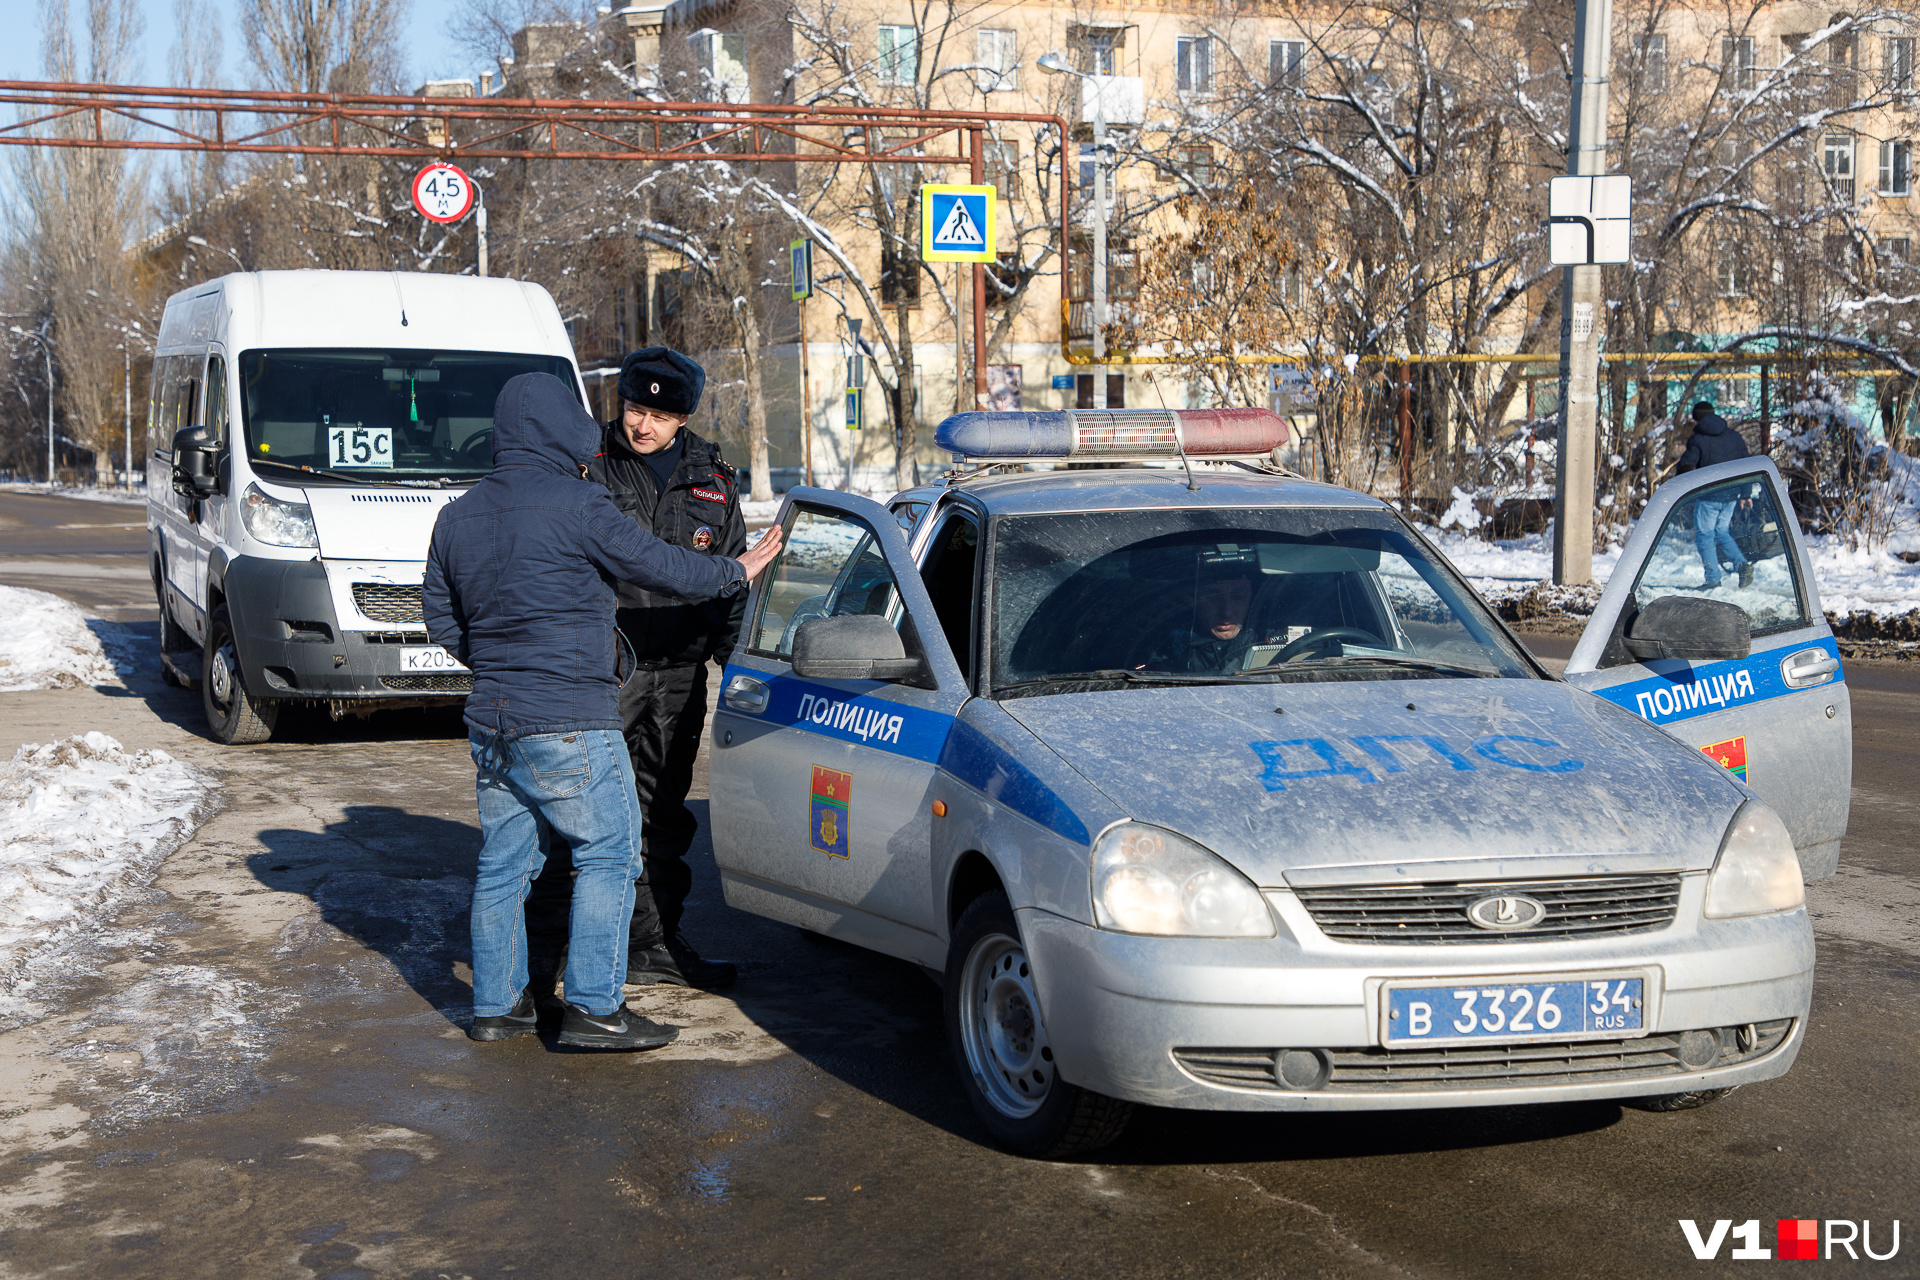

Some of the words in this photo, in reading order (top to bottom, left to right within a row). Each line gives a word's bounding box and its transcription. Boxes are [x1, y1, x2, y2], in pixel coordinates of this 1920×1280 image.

[425, 177, 460, 198] 4,5
[693, 488, 725, 501] ПОЛИЦИЯ
[797, 693, 904, 744] ПОЛИЦИЯ
[1636, 669, 1755, 719] ПОЛИЦИЯ
[1248, 735, 1585, 793] ДПС
[1453, 987, 1562, 1034] 3326
[1590, 980, 1630, 1015] 34
[1595, 1015, 1625, 1029] RUS
